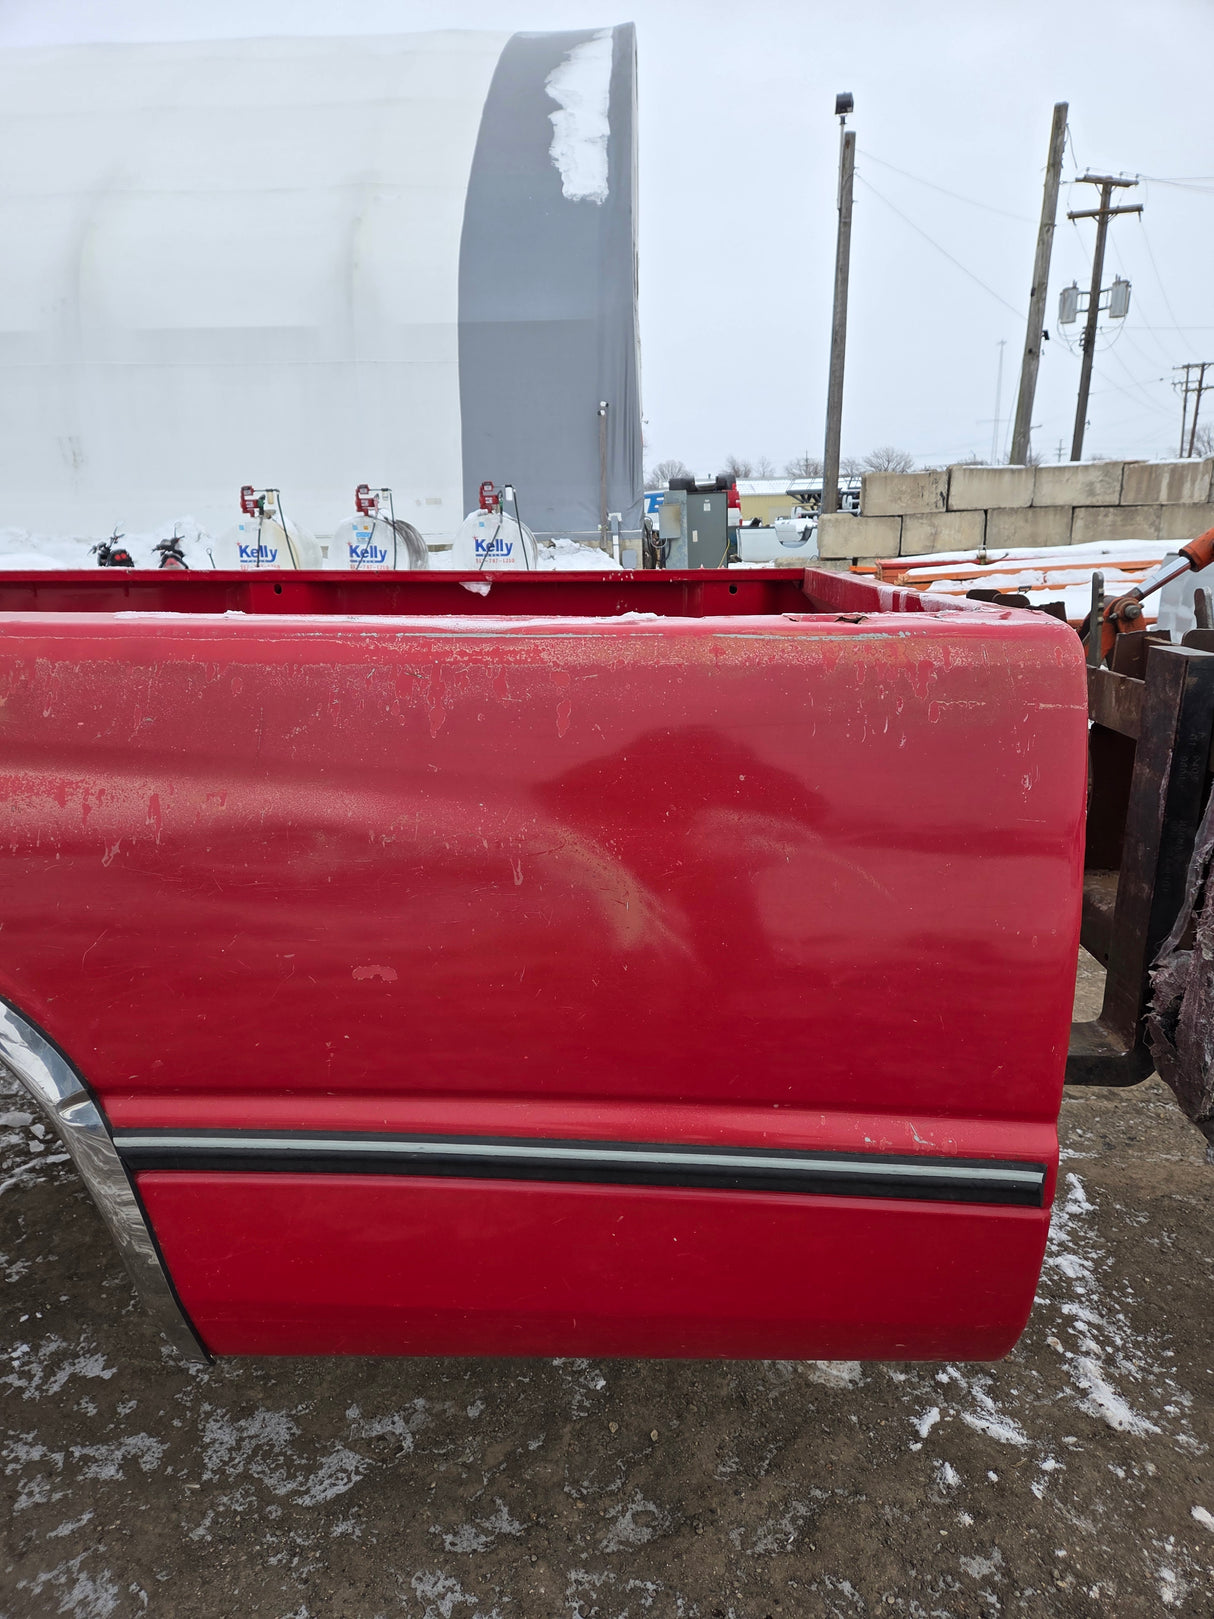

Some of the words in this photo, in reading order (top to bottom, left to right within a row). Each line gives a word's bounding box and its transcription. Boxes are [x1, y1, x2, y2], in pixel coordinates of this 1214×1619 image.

[239, 544, 278, 563] Kelly
[349, 545, 388, 563] Kelly
[475, 538, 513, 556] Kelly
